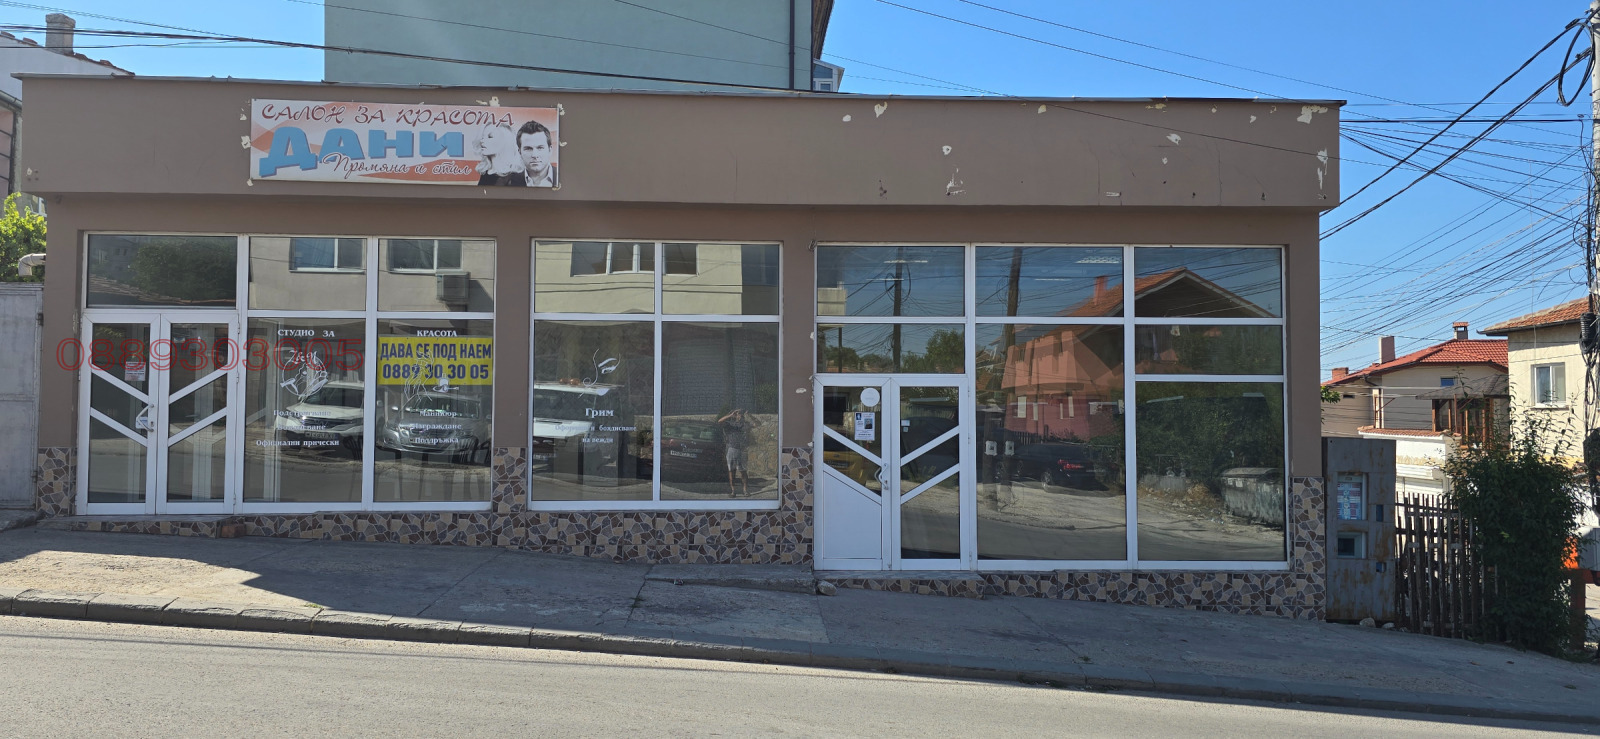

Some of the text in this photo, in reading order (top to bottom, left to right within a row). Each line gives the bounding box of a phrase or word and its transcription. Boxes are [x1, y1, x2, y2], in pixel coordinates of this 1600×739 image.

[261, 103, 515, 127] САЛОН ЗА КРАСОТА
[258, 126, 465, 178] ДАНИ
[322, 152, 473, 179] Промяна и стил
[277, 329, 315, 337] СТУДИО
[416, 329, 458, 337] КРАСОТА
[380, 343, 492, 361] ДАВА СЕ ПОД НАЕМ
[383, 363, 420, 379] 0889
[447, 364, 466, 379] 30
[470, 364, 489, 379] 05
[585, 408, 614, 418] Грим
